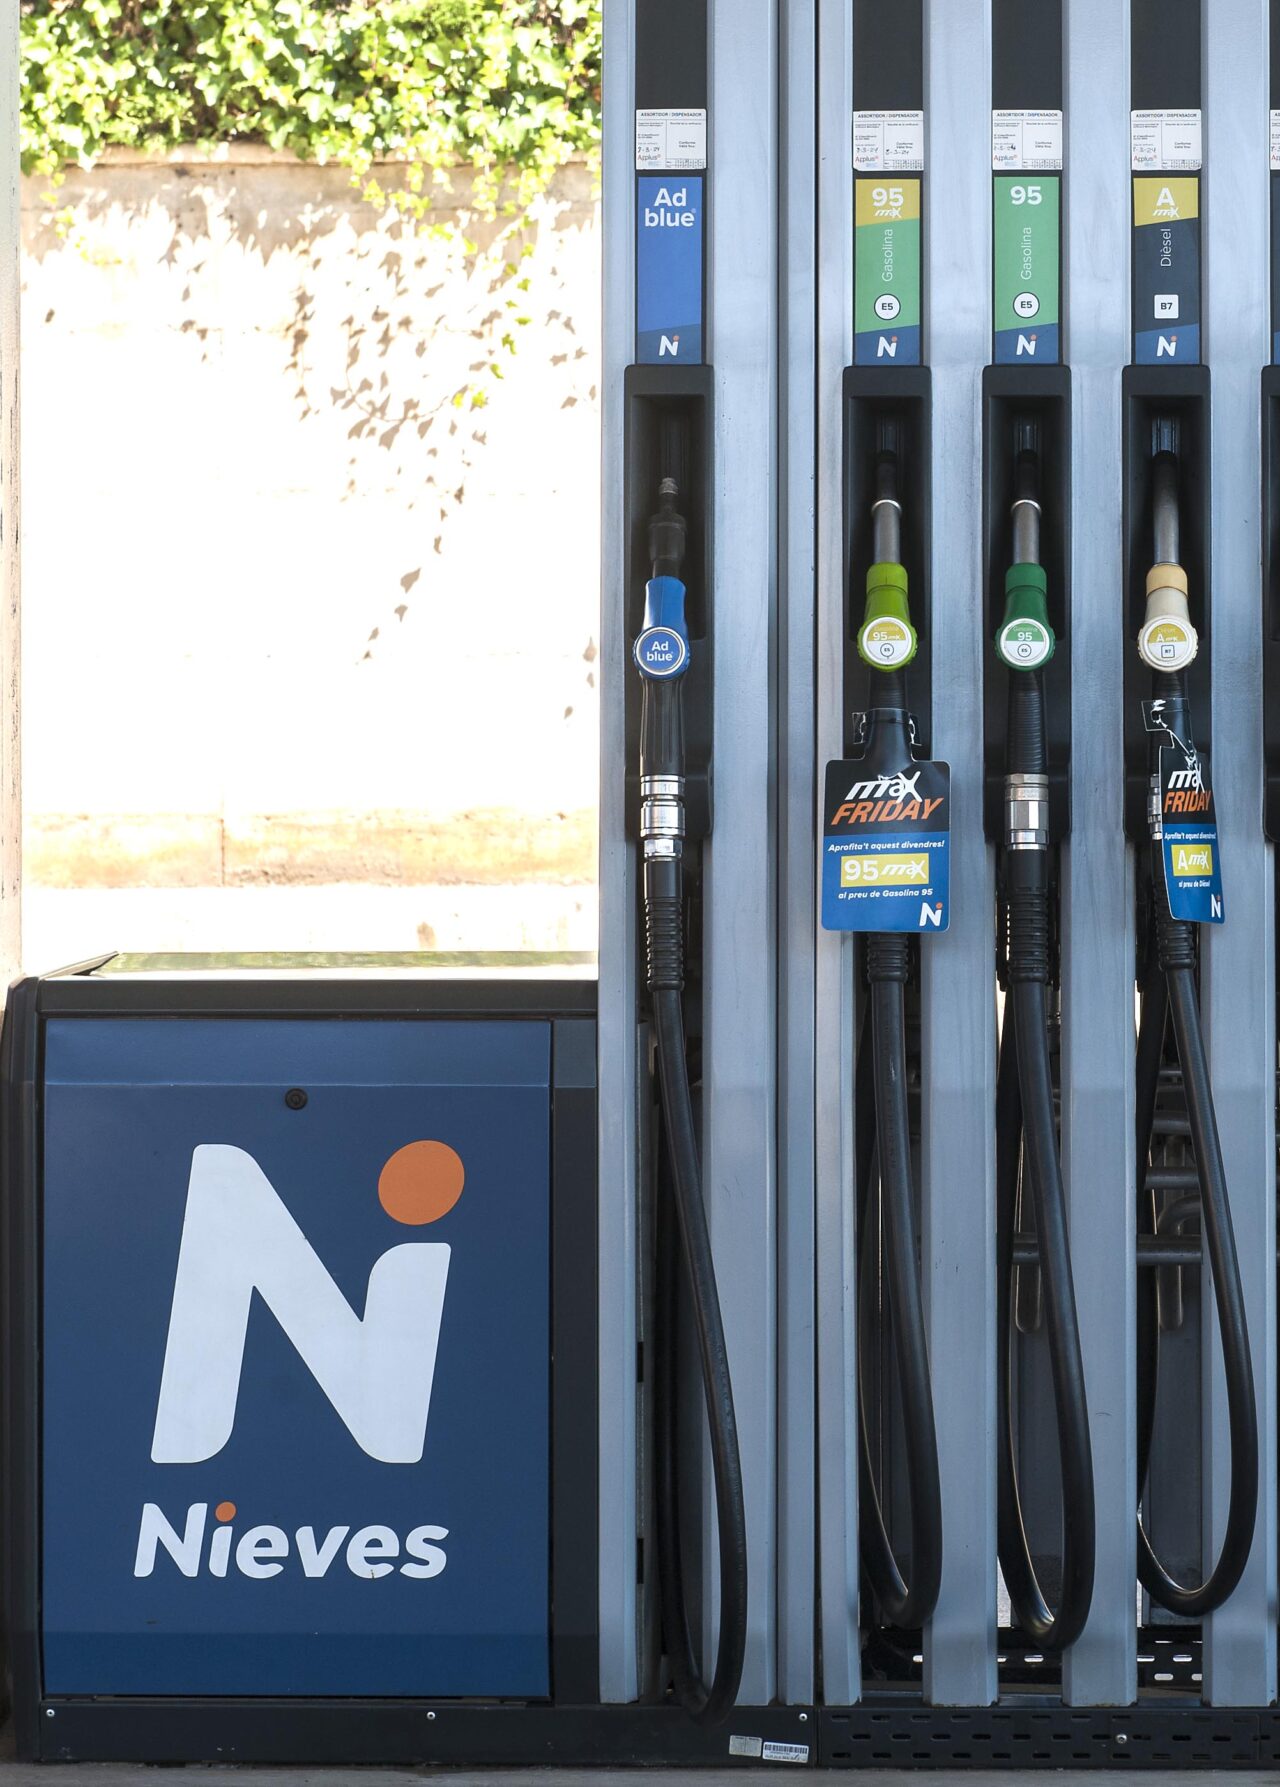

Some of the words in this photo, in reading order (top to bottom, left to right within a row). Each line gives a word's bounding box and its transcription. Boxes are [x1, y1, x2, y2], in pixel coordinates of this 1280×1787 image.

[654, 188, 686, 206] Ad
[872, 187, 904, 207] 95
[1010, 185, 1042, 205] 95
[1156, 187, 1175, 206] A
[882, 229, 893, 281] Gasolina
[1020, 227, 1031, 280] Gasolina
[1160, 229, 1171, 267] Dièsel
[881, 303, 893, 311] E5
[1020, 301, 1032, 309] E5
[1160, 302, 1172, 310] B7
[873, 631, 888, 641] 95
[1017, 631, 1033, 641] 95
[1156, 633, 1165, 642] A
[651, 641, 669, 651] Ad
[1164, 790, 1212, 813] FRIDAY
[831, 797, 945, 826] FRIDAY
[828, 843, 869, 853] Aprofita't
[870, 842, 900, 850] aquest
[901, 840, 945, 849] divendres!
[1178, 849, 1188, 871] A
[844, 859, 879, 881] 95
[838, 891, 847, 899] al
[848, 892, 868, 900] preu
[869, 890, 881, 898] de
[882, 889, 920, 897] Gasolina
[921, 888, 933, 896] 95
[133, 1501, 449, 1579] Nieves
